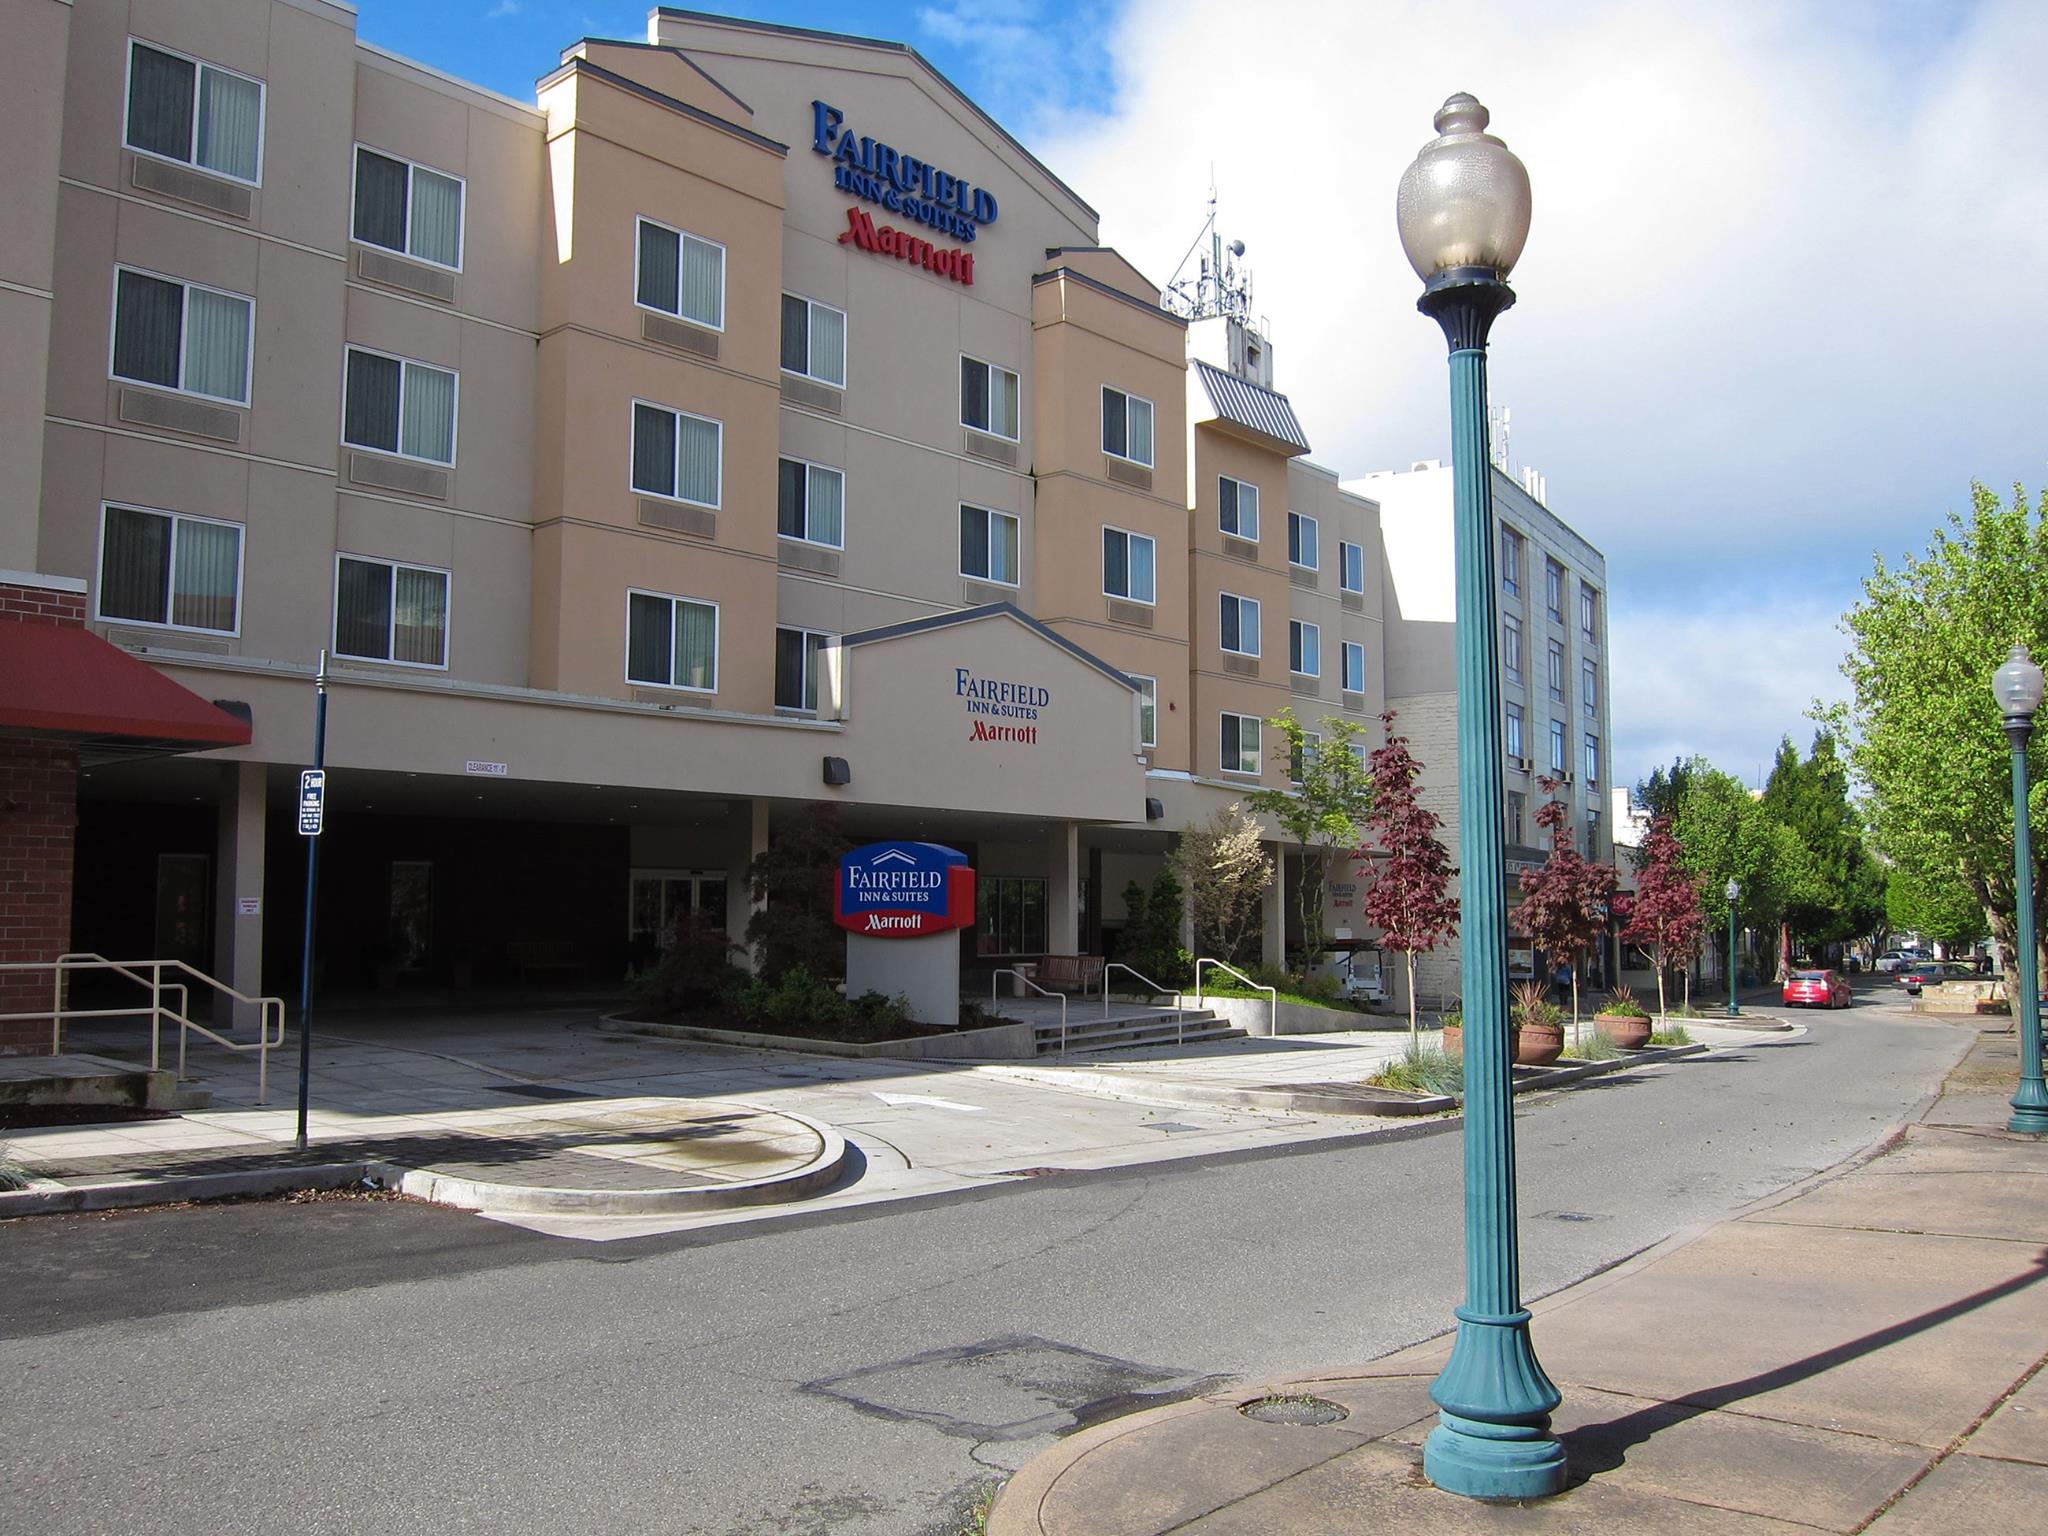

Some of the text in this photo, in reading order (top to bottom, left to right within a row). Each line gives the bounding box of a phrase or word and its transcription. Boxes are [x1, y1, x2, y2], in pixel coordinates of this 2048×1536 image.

[811, 100, 998, 225] FAIRFIELD
[834, 166, 977, 243] INN & SUITES
[837, 206, 975, 286] Marriott
[955, 667, 1049, 708] FAIRFIELD
[967, 700, 1038, 720] INN & SUITES
[969, 719, 1037, 745] Marriott
[304, 774, 311, 789] 2
[848, 865, 942, 890] FAIRFIELD
[859, 891, 929, 902] INN & SUITES
[864, 913, 922, 931] Marriott
